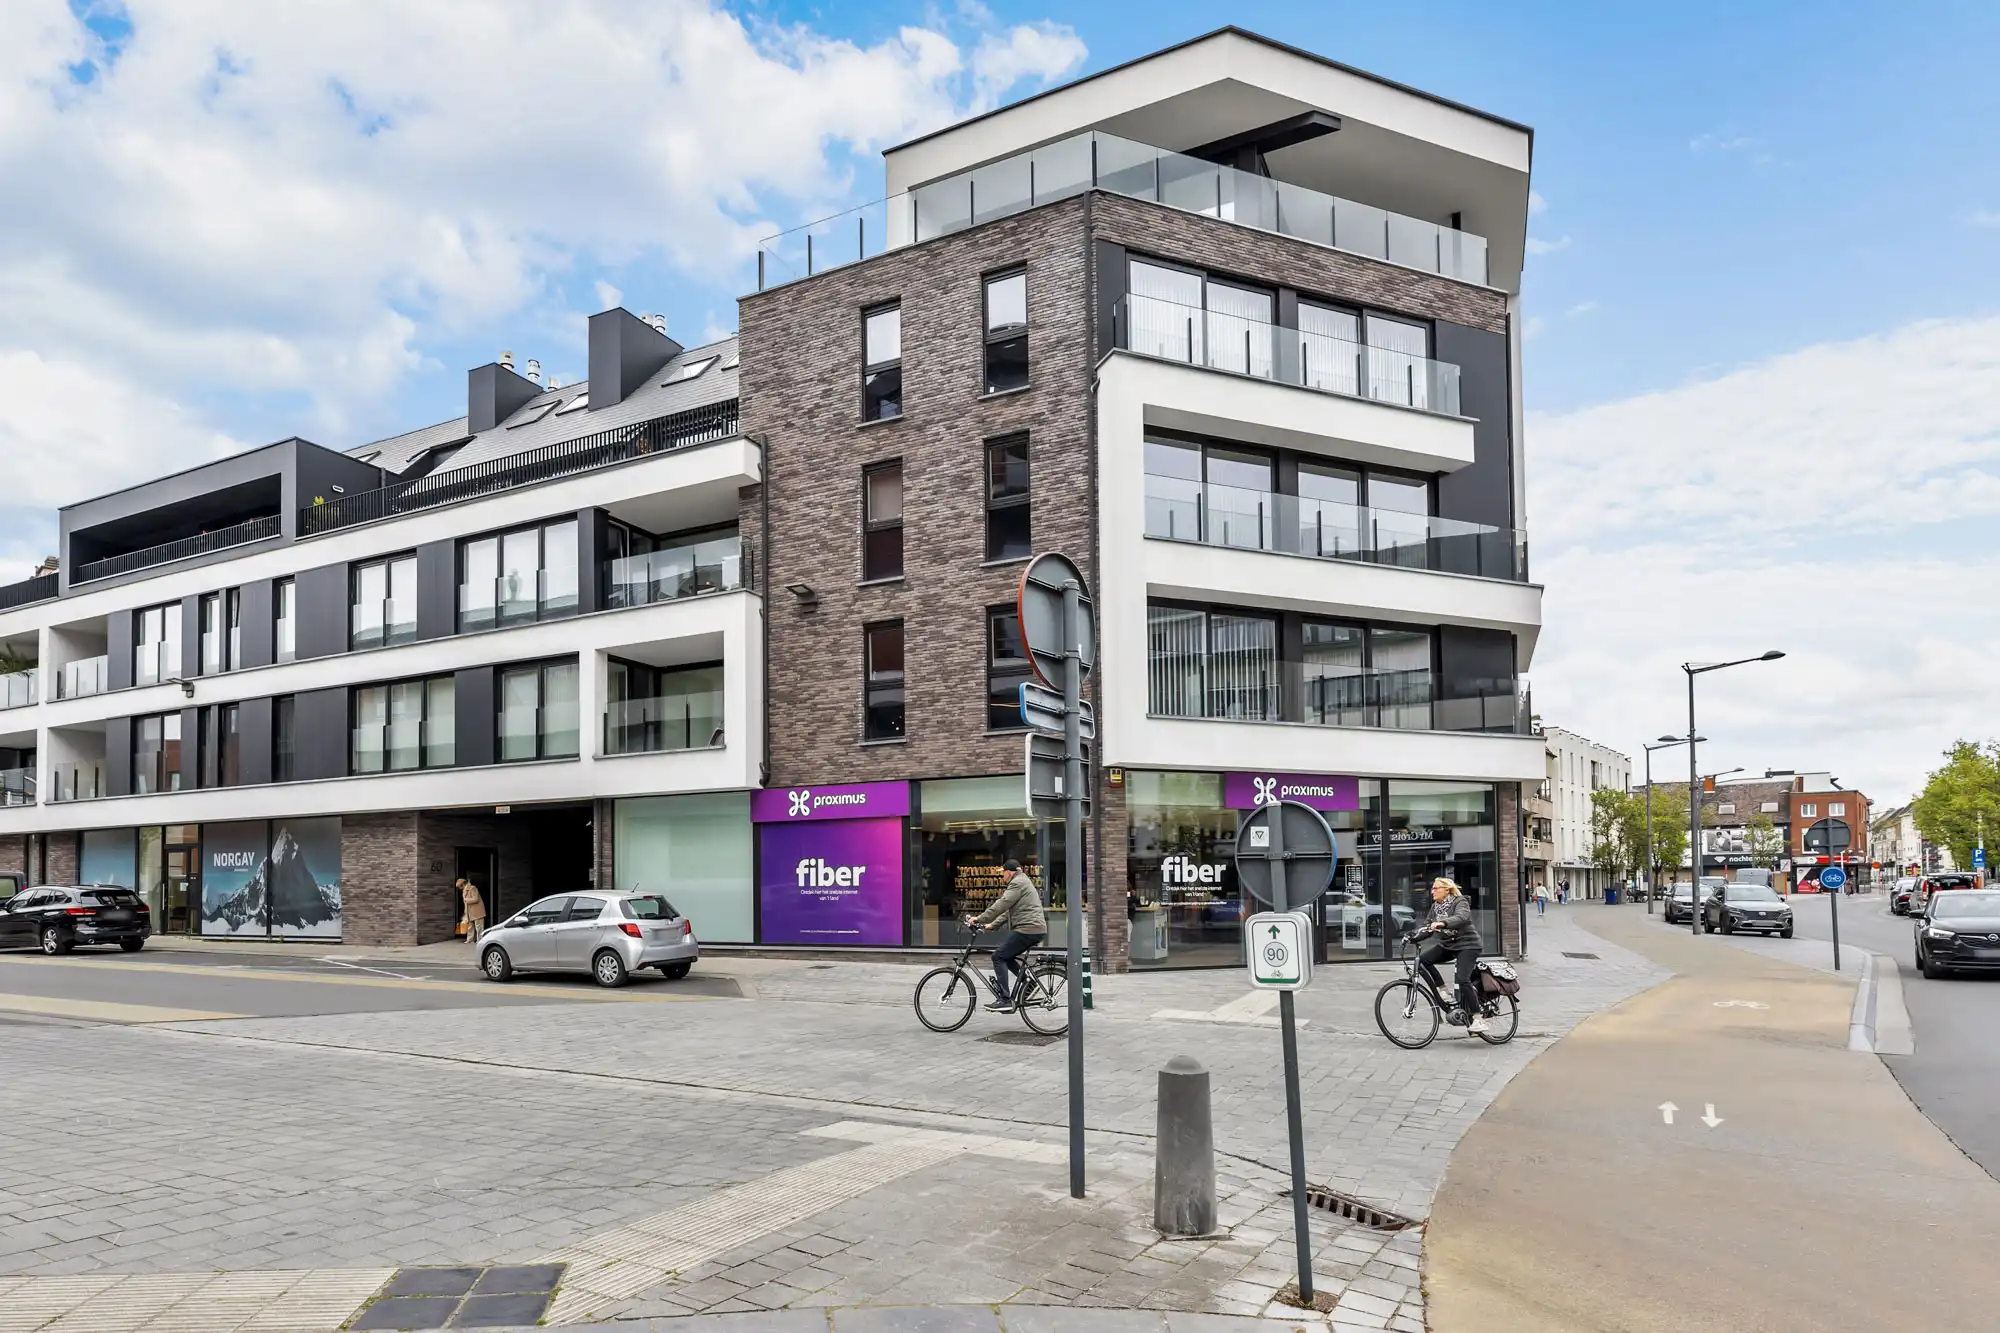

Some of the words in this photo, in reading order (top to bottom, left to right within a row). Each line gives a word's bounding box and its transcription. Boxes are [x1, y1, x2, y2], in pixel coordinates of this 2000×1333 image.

[1281, 785, 1334, 798] proximus
[813, 793, 866, 808] proximus
[213, 851, 255, 867] NORGAY
[796, 858, 866, 887] fiber
[1161, 856, 1227, 883] fiber
[1267, 948, 1284, 961] 90
